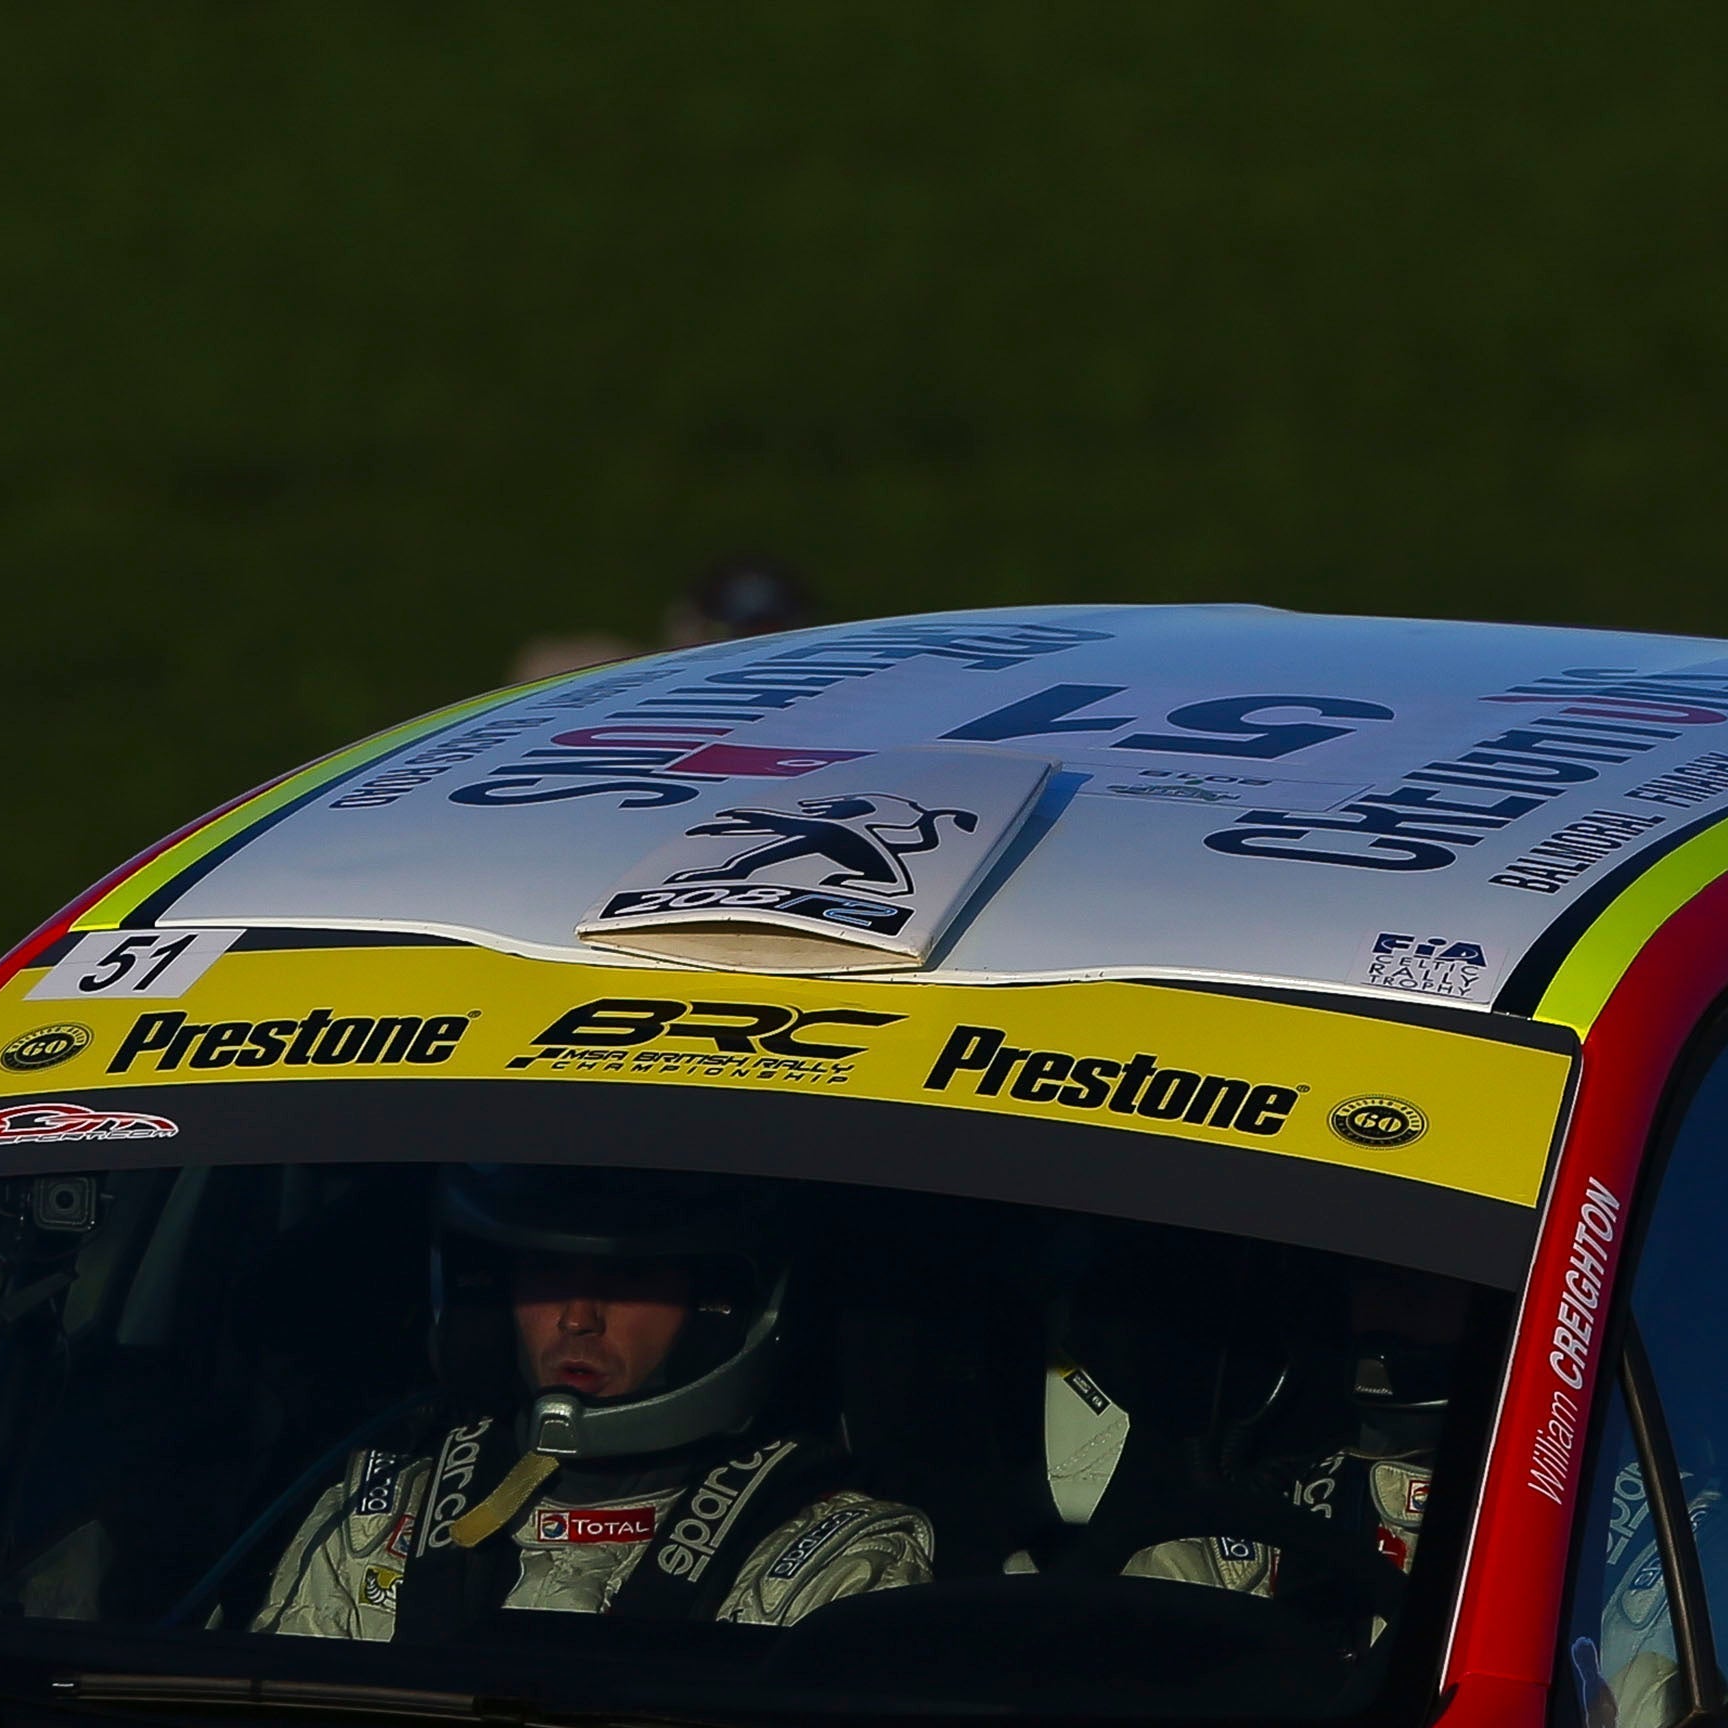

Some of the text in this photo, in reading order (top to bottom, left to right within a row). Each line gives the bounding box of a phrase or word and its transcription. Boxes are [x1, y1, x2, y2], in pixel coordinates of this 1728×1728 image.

[1487, 810, 1667, 894] BALMORAL
[78, 934, 198, 994] 51
[1369, 962, 1480, 988] RALLY
[1369, 974, 1472, 997] TROPHY
[1375, 954, 1480, 976] CELTIC
[104, 1005, 470, 1075] Prestone
[529, 997, 912, 1060] BRC
[550, 1060, 850, 1084] CHAMPIONSHIP
[561, 1048, 857, 1075] MSA BRITISH RALLY
[924, 1025, 1300, 1136] Prestone
[1527, 1176, 1622, 1506] William CREIGHTON
[571, 1517, 651, 1538] TOTAL
